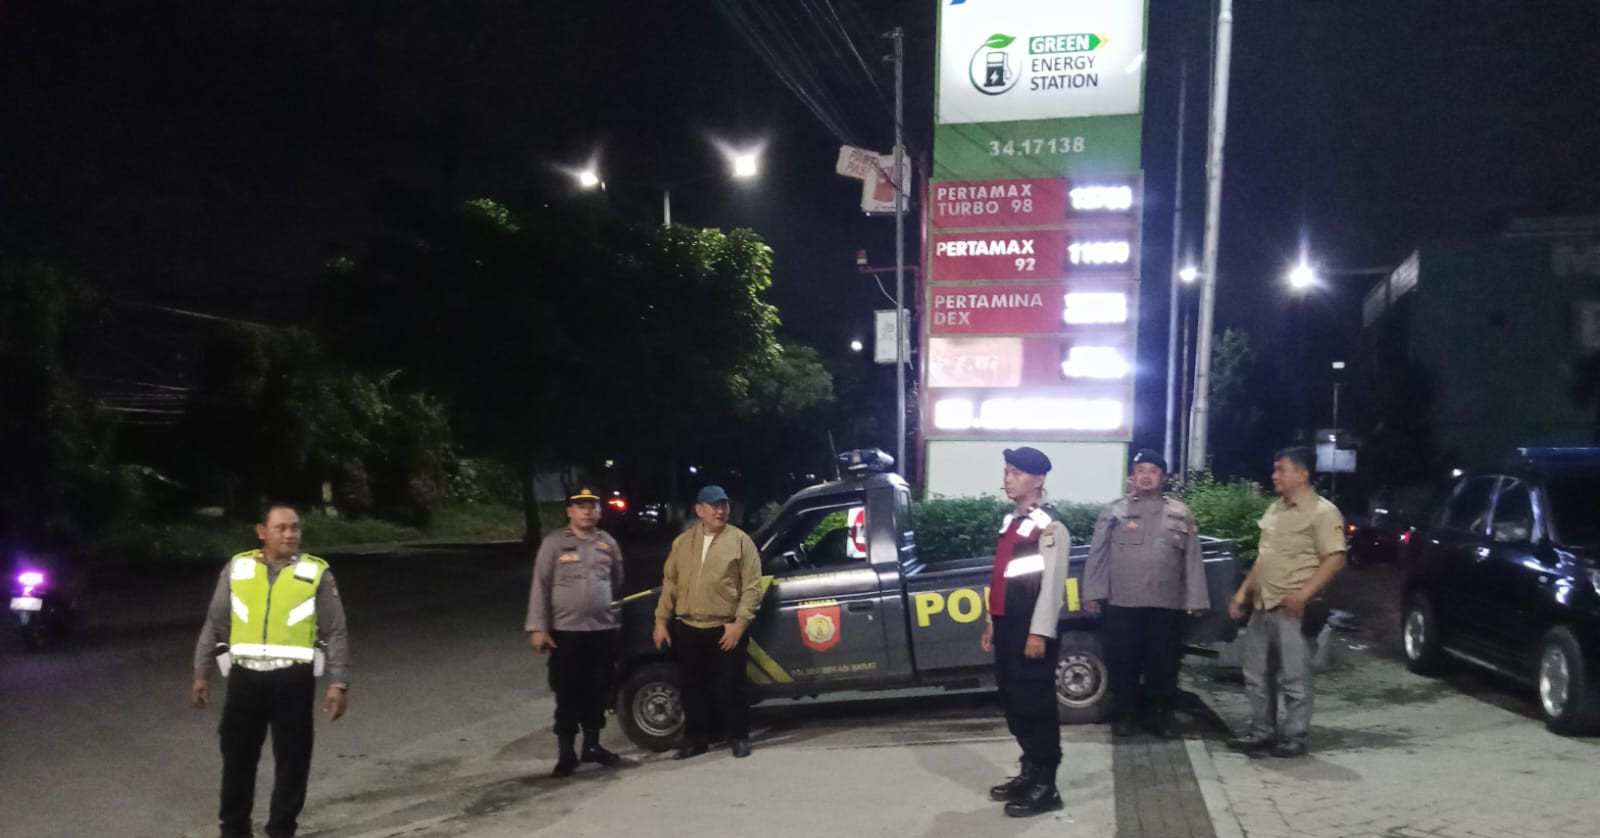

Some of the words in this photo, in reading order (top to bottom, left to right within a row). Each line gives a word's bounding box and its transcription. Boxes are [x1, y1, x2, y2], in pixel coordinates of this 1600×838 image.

[1031, 35, 1091, 53] GREEN
[1031, 56, 1096, 73] ENERGY
[1030, 73, 1099, 91] STATION
[989, 137, 1086, 157] 34.17138
[937, 184, 1033, 201] PERTAMAX
[937, 201, 999, 216] TURBO
[1011, 199, 1033, 213] 98
[936, 239, 1035, 257] PERTAMAX
[1015, 258, 1036, 272] 92
[934, 293, 1044, 309] PERTAMINA
[934, 312, 971, 325] DEX
[915, 578, 1081, 627] POI
